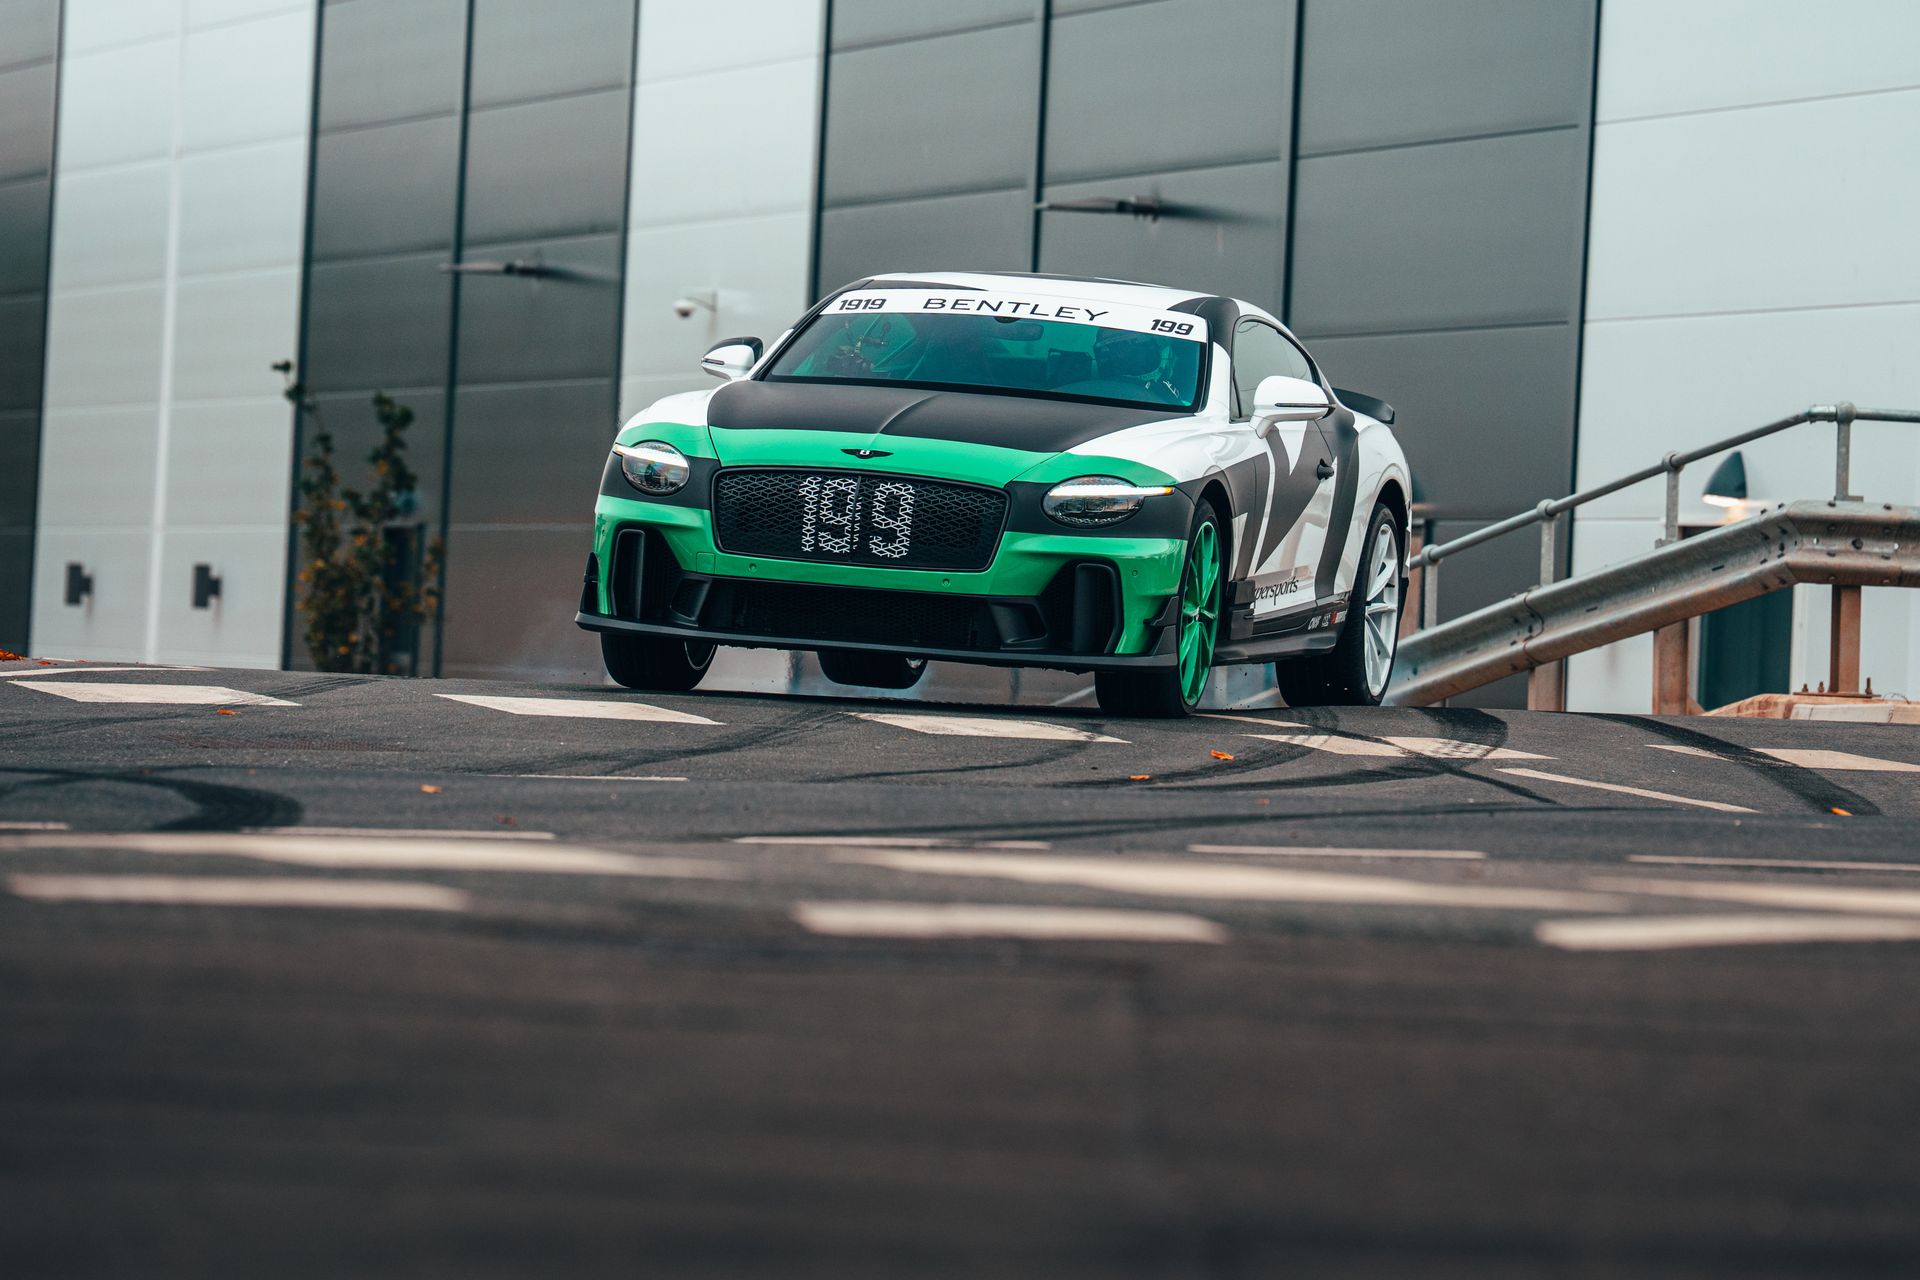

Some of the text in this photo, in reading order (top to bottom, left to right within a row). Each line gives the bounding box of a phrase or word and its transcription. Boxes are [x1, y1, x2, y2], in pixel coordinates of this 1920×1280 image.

[838, 298, 887, 311] 1919
[922, 298, 1109, 321] BENTLEY
[1150, 319, 1194, 336] 199
[799, 476, 916, 558] 199
